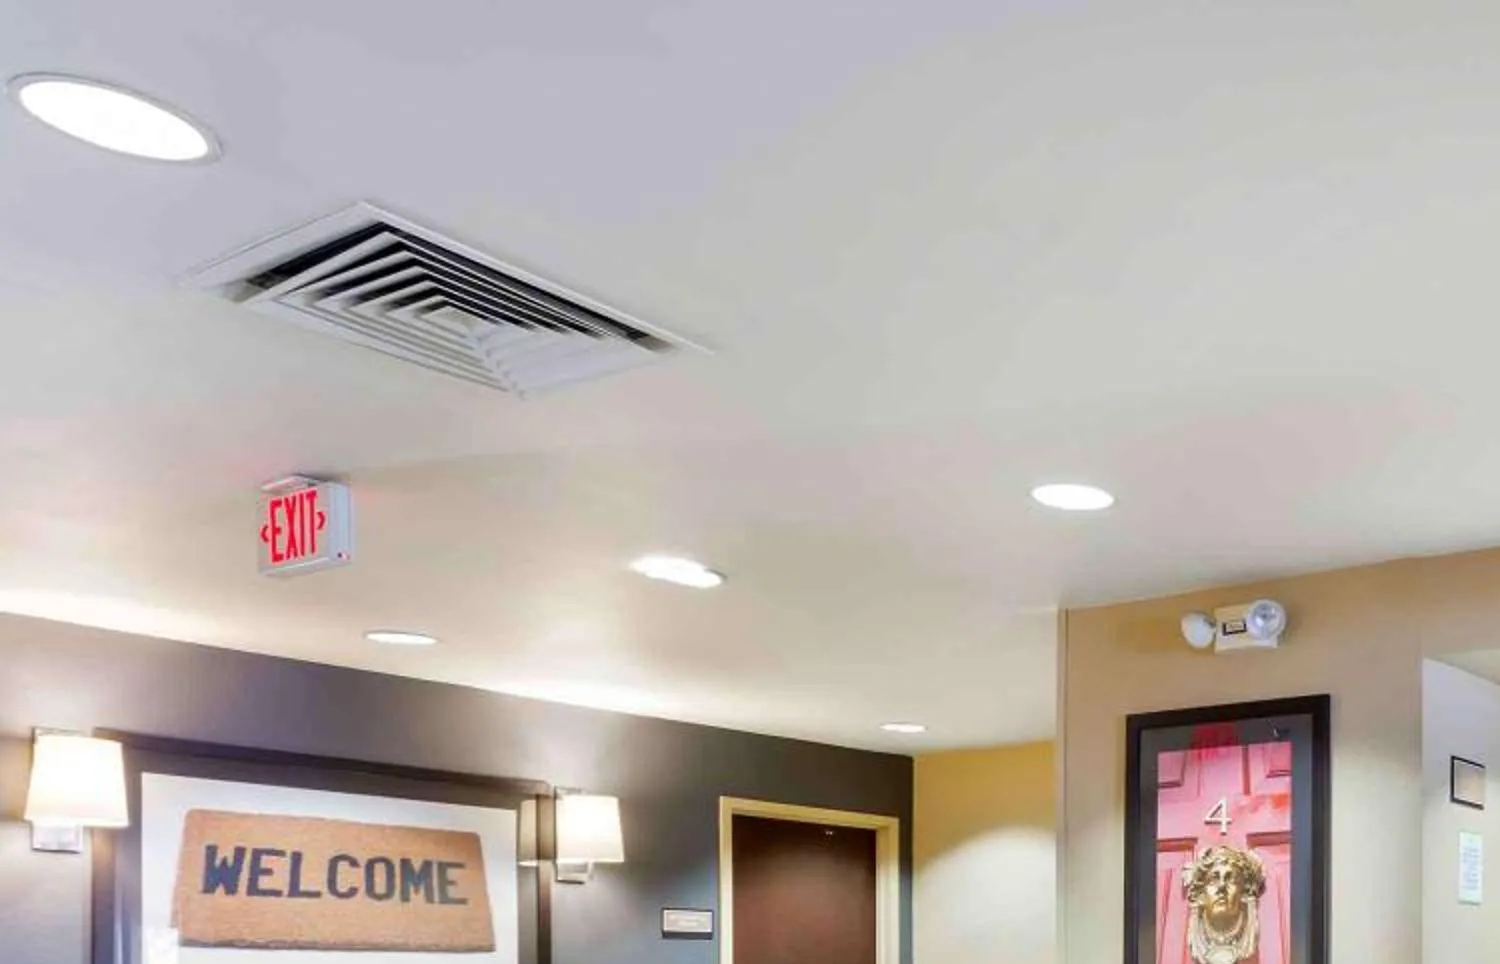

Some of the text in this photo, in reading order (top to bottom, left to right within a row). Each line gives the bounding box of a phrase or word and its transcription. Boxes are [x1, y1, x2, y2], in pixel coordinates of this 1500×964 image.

[269, 488, 317, 564] EXIT
[1204, 796, 1232, 835] 4
[200, 844, 469, 905] WELCOME
